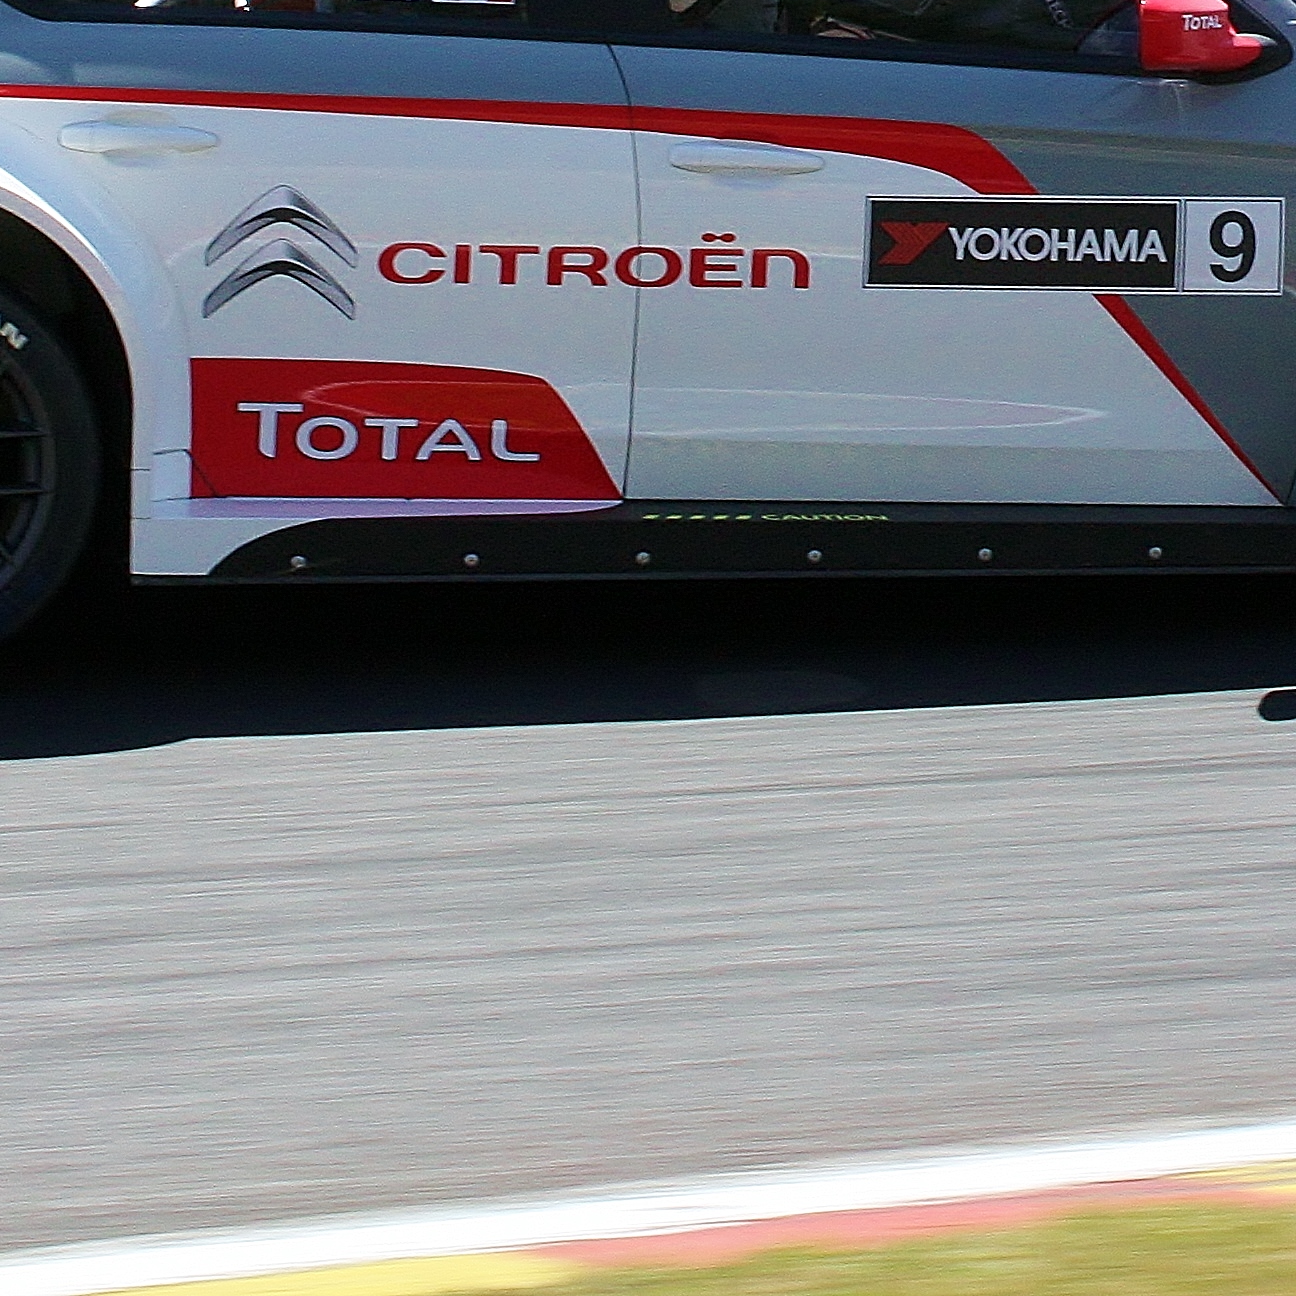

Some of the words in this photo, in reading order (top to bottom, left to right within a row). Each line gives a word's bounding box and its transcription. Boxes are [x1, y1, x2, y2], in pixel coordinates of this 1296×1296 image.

[948, 227, 1168, 263] YOKOHAMA
[1208, 210, 1257, 283] 9
[761, 513, 890, 521] CAUTION
